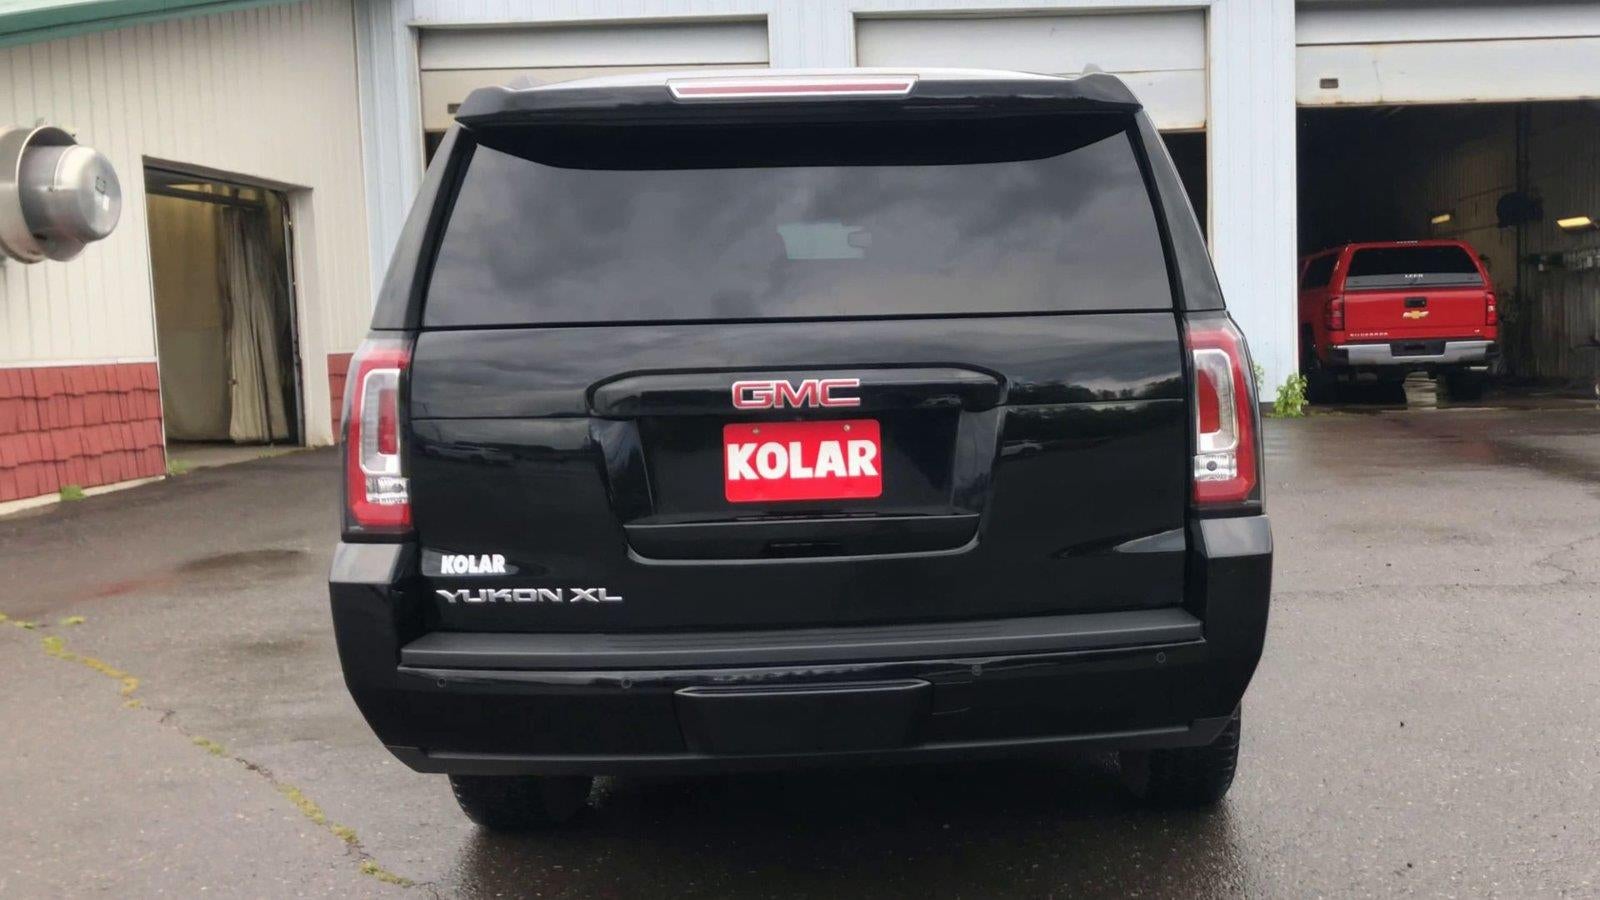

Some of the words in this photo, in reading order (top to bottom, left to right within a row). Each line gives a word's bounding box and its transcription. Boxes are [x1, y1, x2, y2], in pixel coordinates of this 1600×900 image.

[732, 378, 860, 409] GMC
[727, 440, 879, 480] KOLAR
[440, 554, 506, 574] KOLAR
[435, 588, 563, 602] YUKON
[569, 588, 623, 602] XL
